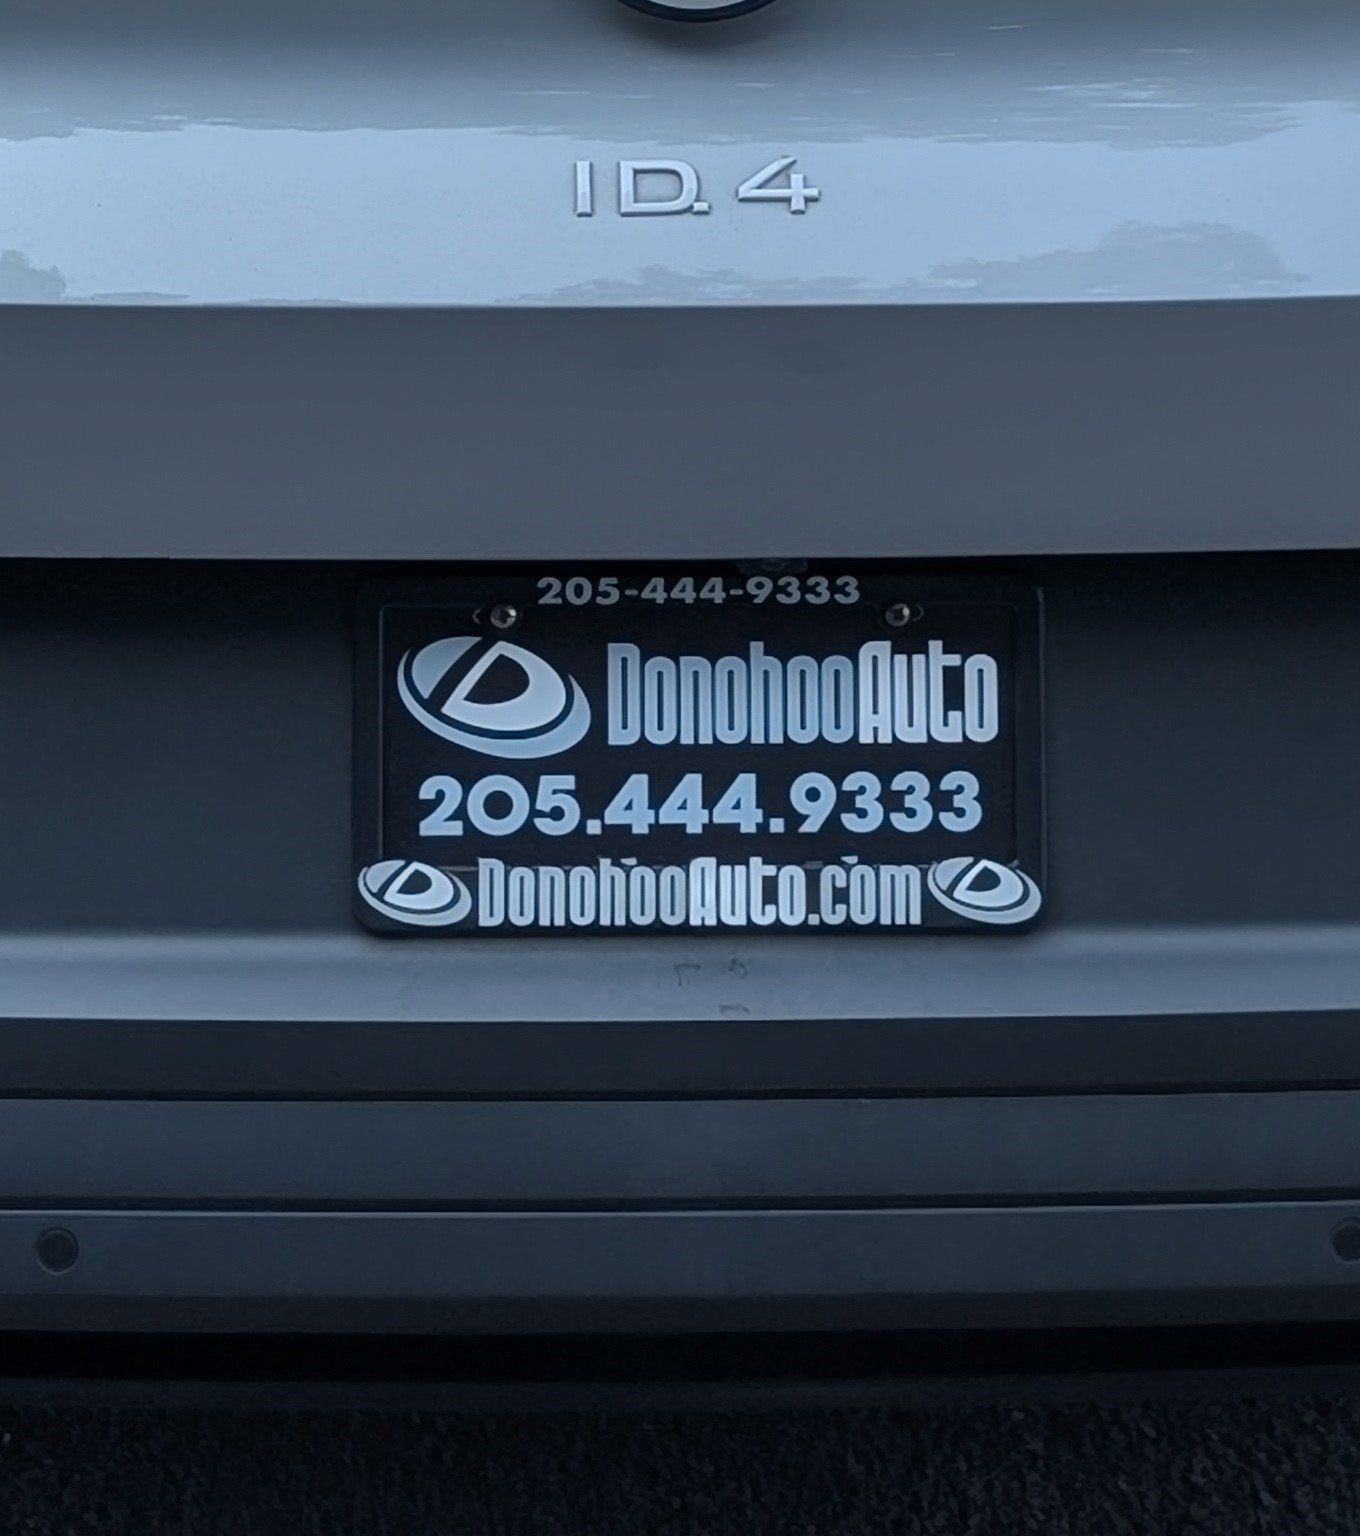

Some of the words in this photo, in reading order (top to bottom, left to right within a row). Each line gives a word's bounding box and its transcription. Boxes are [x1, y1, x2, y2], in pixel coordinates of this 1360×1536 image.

[536, 575, 861, 605] 205-444-9333
[607, 639, 999, 746] DonohooAuto
[418, 770, 982, 837] 205.444.9333
[478, 856, 922, 927] DonohooAuto.com
